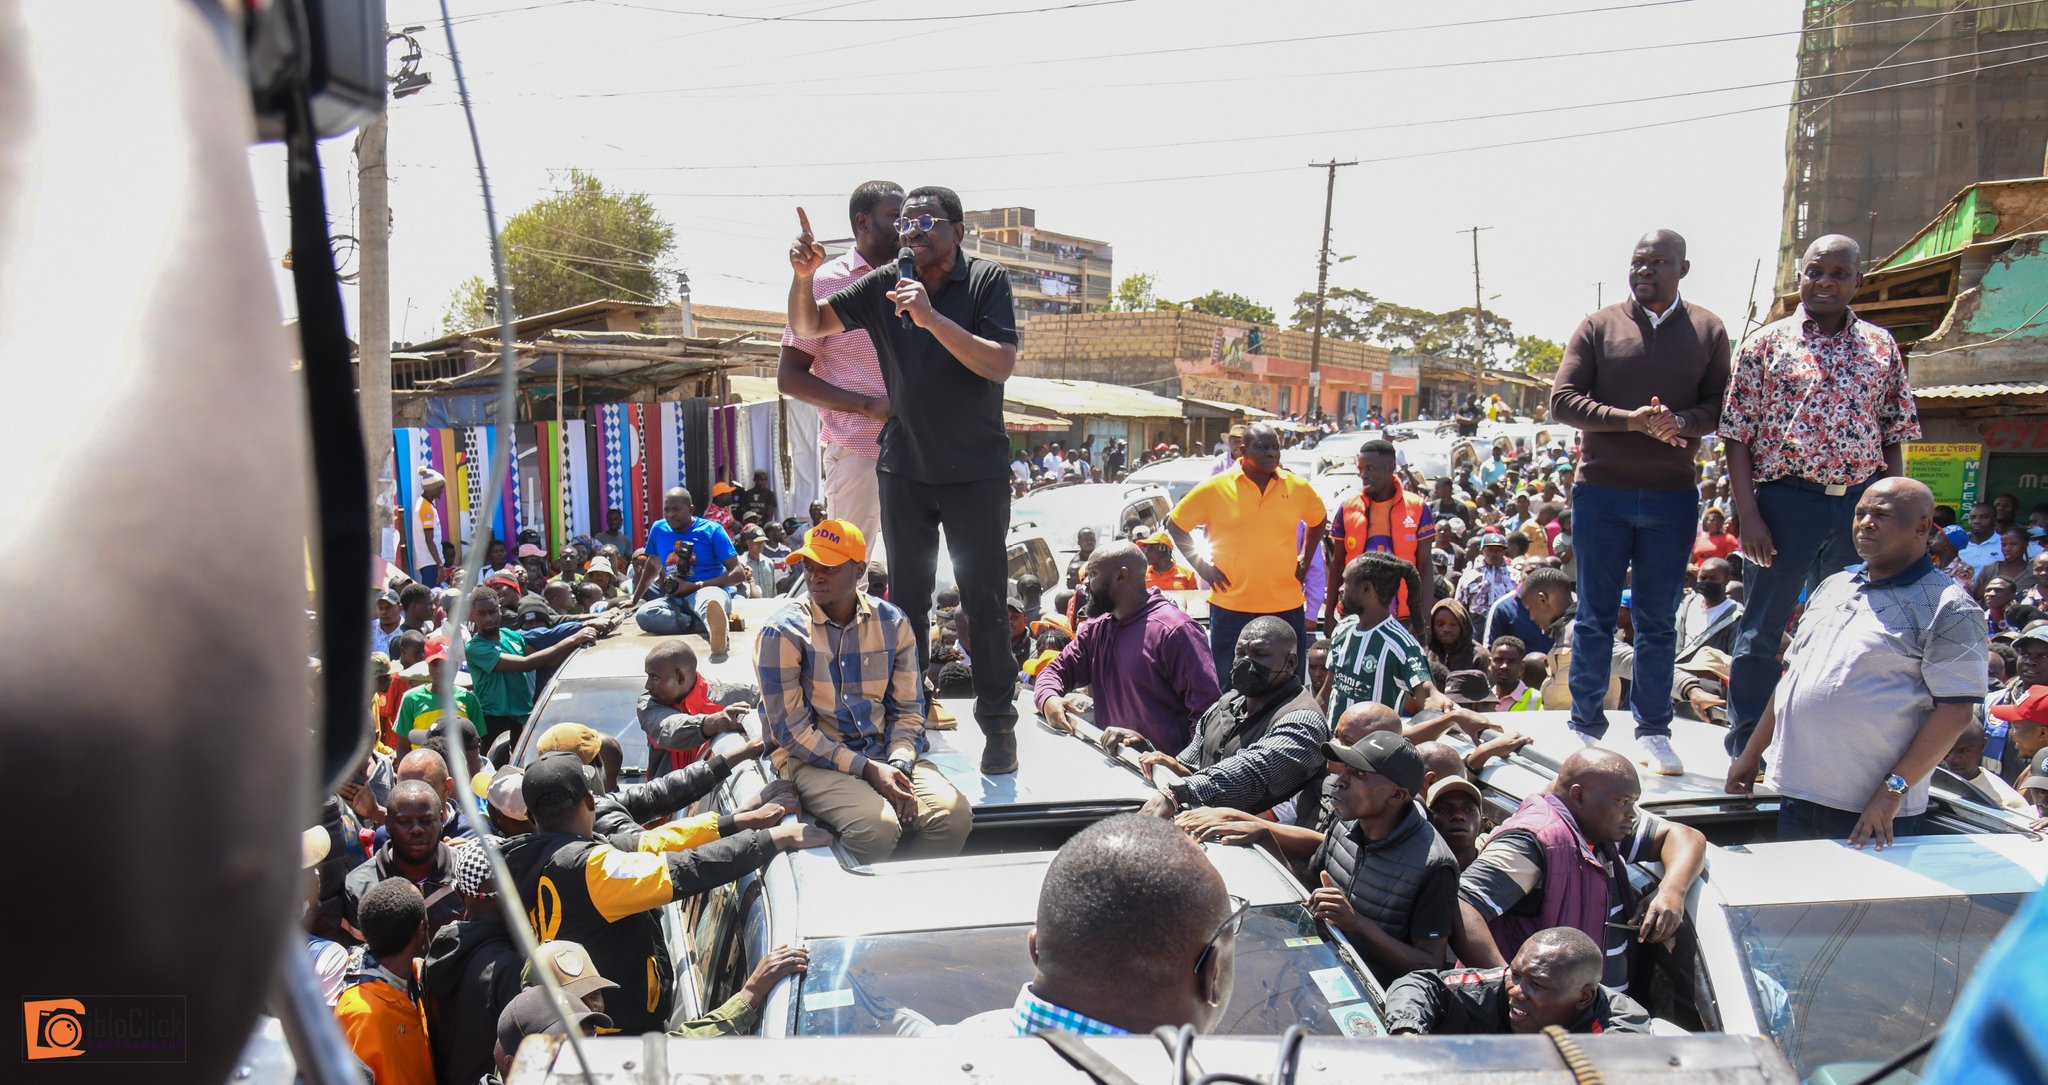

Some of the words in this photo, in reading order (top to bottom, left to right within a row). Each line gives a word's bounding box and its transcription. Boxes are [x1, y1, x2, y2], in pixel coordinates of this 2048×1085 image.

[1908, 445, 1937, 453] STAGE
[1939, 445, 1945, 453] 2
[1946, 445, 1977, 453] CYBER
[812, 528, 841, 544] ODM
